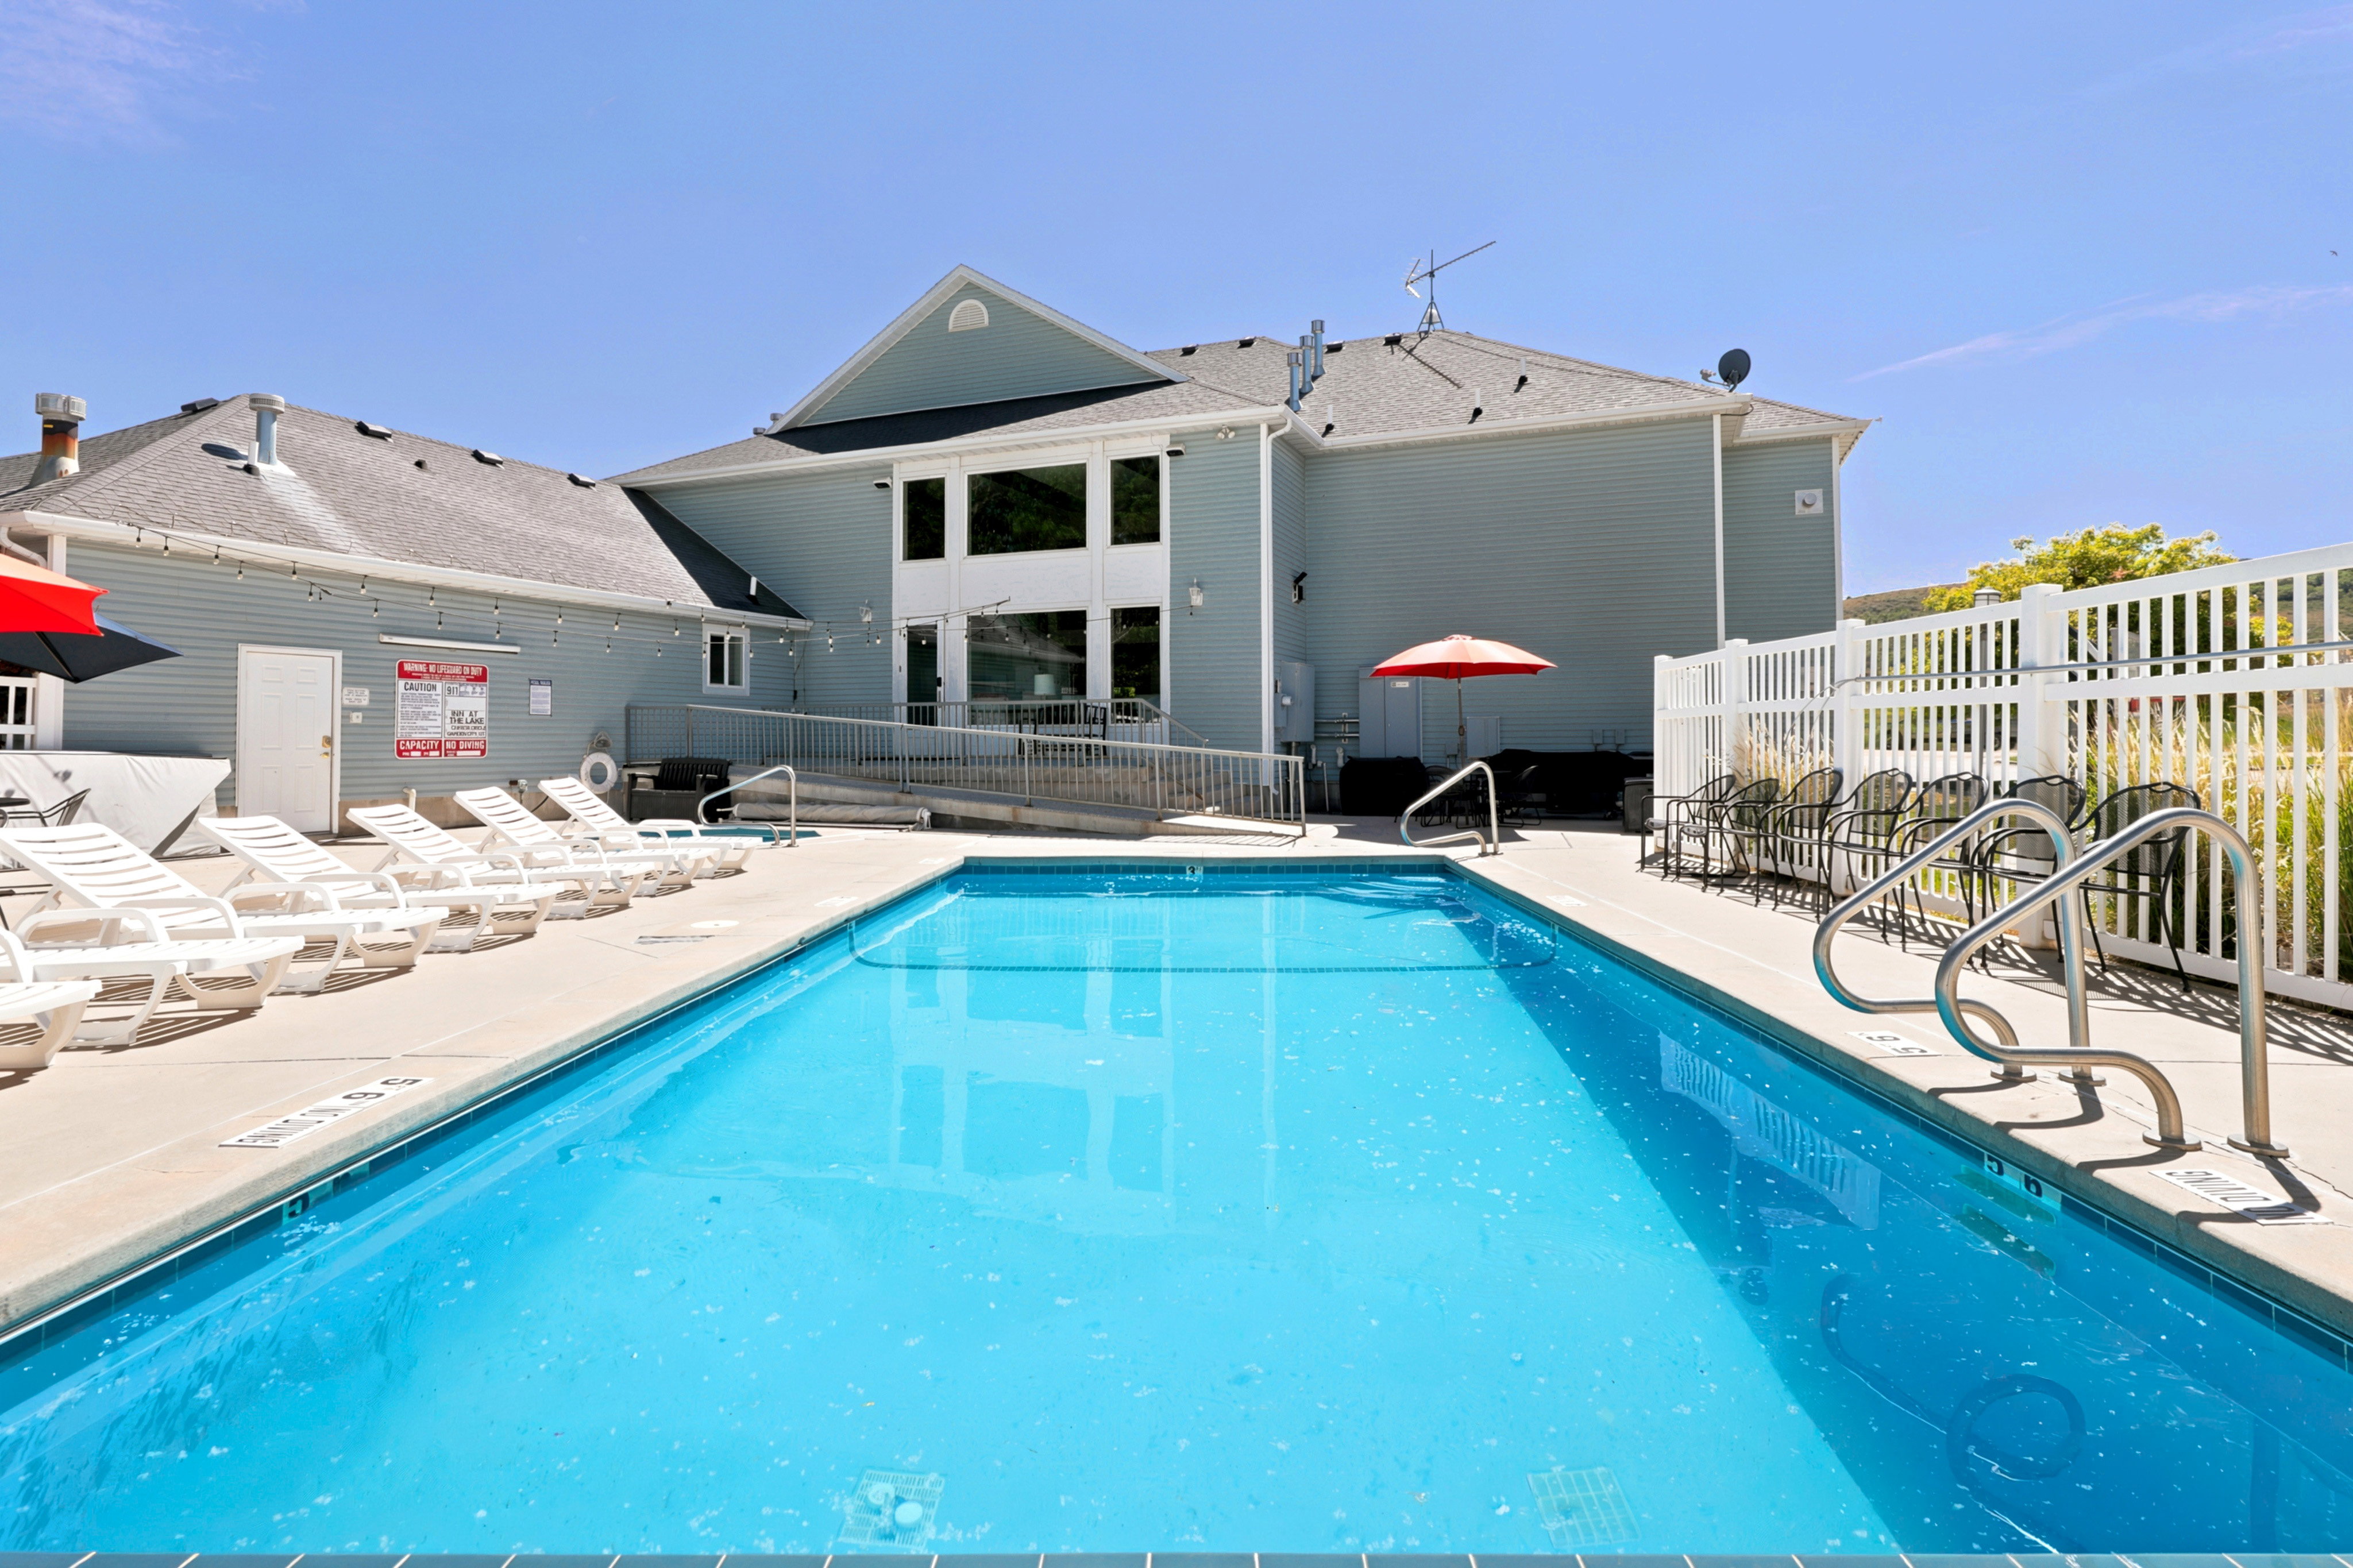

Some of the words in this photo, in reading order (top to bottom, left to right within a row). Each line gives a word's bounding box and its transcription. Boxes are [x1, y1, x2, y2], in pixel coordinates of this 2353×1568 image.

[429, 665, 436, 673] NO
[471, 667, 483, 676] DUTY
[404, 682, 437, 692] CAUTION
[447, 686, 458, 694] 911
[400, 740, 439, 750] CAPACITY
[446, 741, 456, 749] NO
[460, 741, 484, 749] DIVING
[300, 1108, 351, 1117] NO
[236, 1119, 325, 1143] DIVING
[2165, 1171, 2271, 1202] DIVING
[2243, 1205, 2315, 1220] NO
